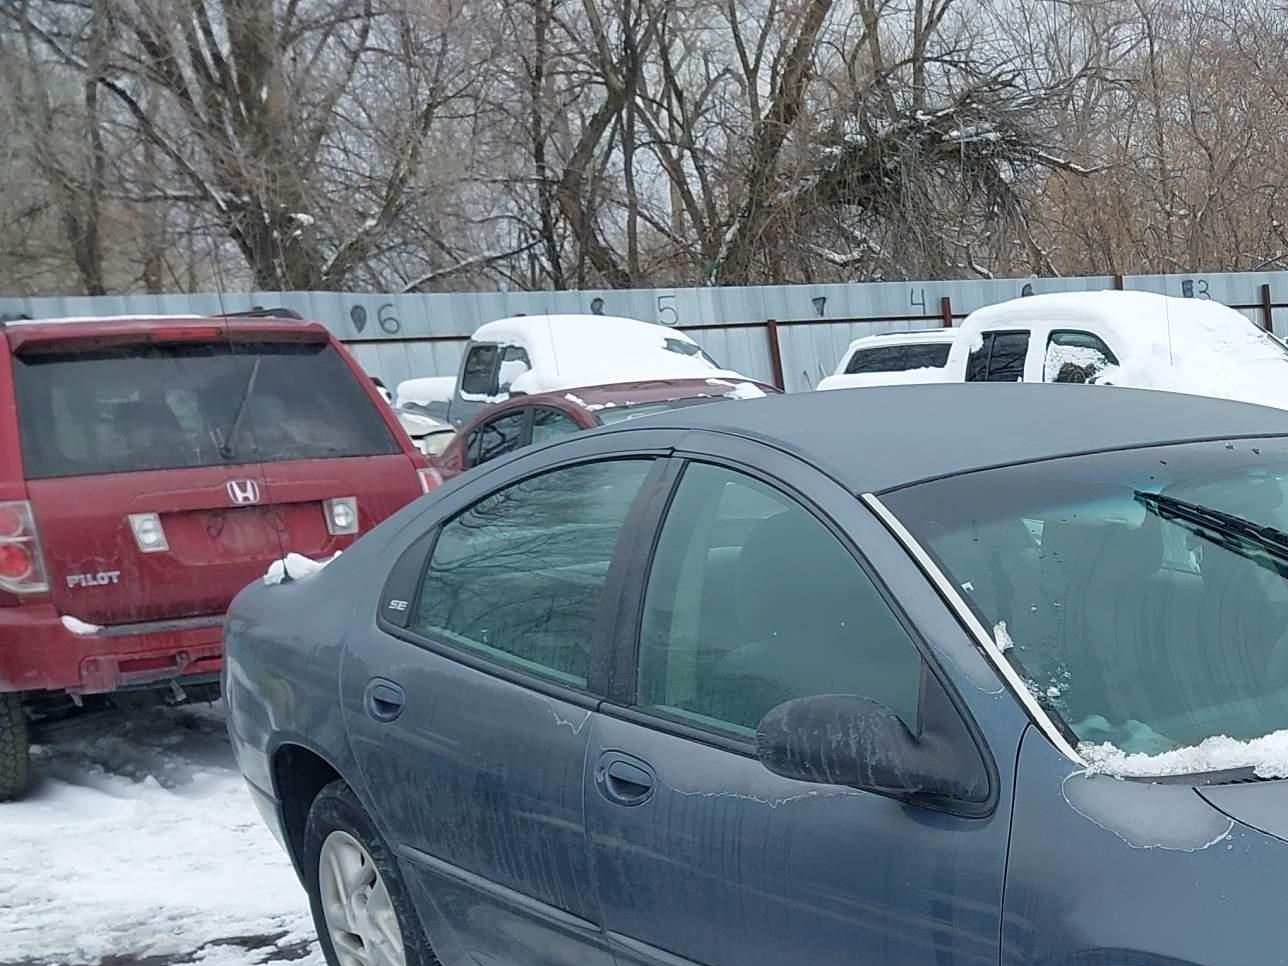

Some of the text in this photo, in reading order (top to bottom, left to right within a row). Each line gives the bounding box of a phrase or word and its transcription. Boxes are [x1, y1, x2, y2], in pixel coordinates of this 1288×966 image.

[656, 295, 679, 326] 5
[910, 287, 926, 315] 4
[377, 303, 401, 335] 6
[66, 571, 121, 589] PILOT
[388, 599, 409, 611] SE
